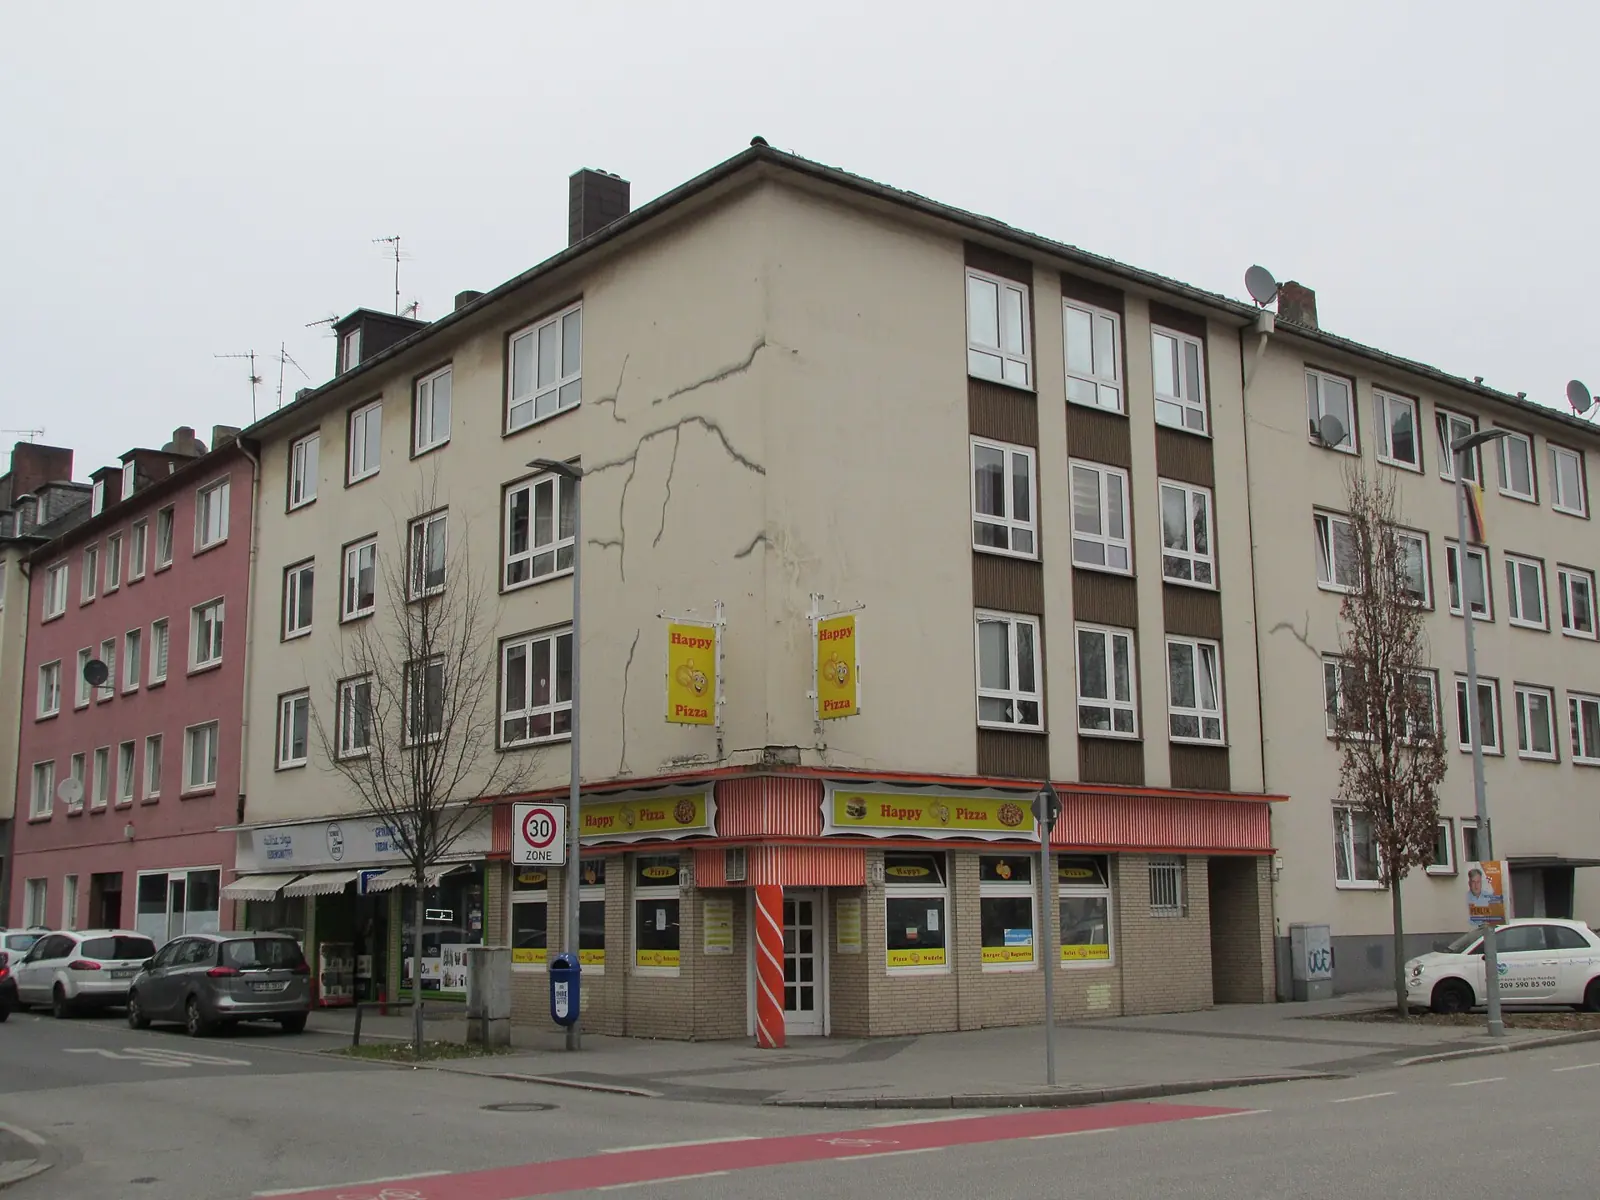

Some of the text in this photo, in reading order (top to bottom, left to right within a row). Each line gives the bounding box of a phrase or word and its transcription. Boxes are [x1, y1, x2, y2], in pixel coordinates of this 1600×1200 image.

[819, 626, 853, 641] Happy
[671, 633, 713, 650] Happy
[675, 705, 708, 718] Pizza
[823, 699, 850, 711] Pizza
[585, 808, 665, 828] Happy Pizza
[880, 804, 987, 820] Happy Pizza
[529, 819, 549, 837] 30
[526, 850, 552, 861] ZONE
